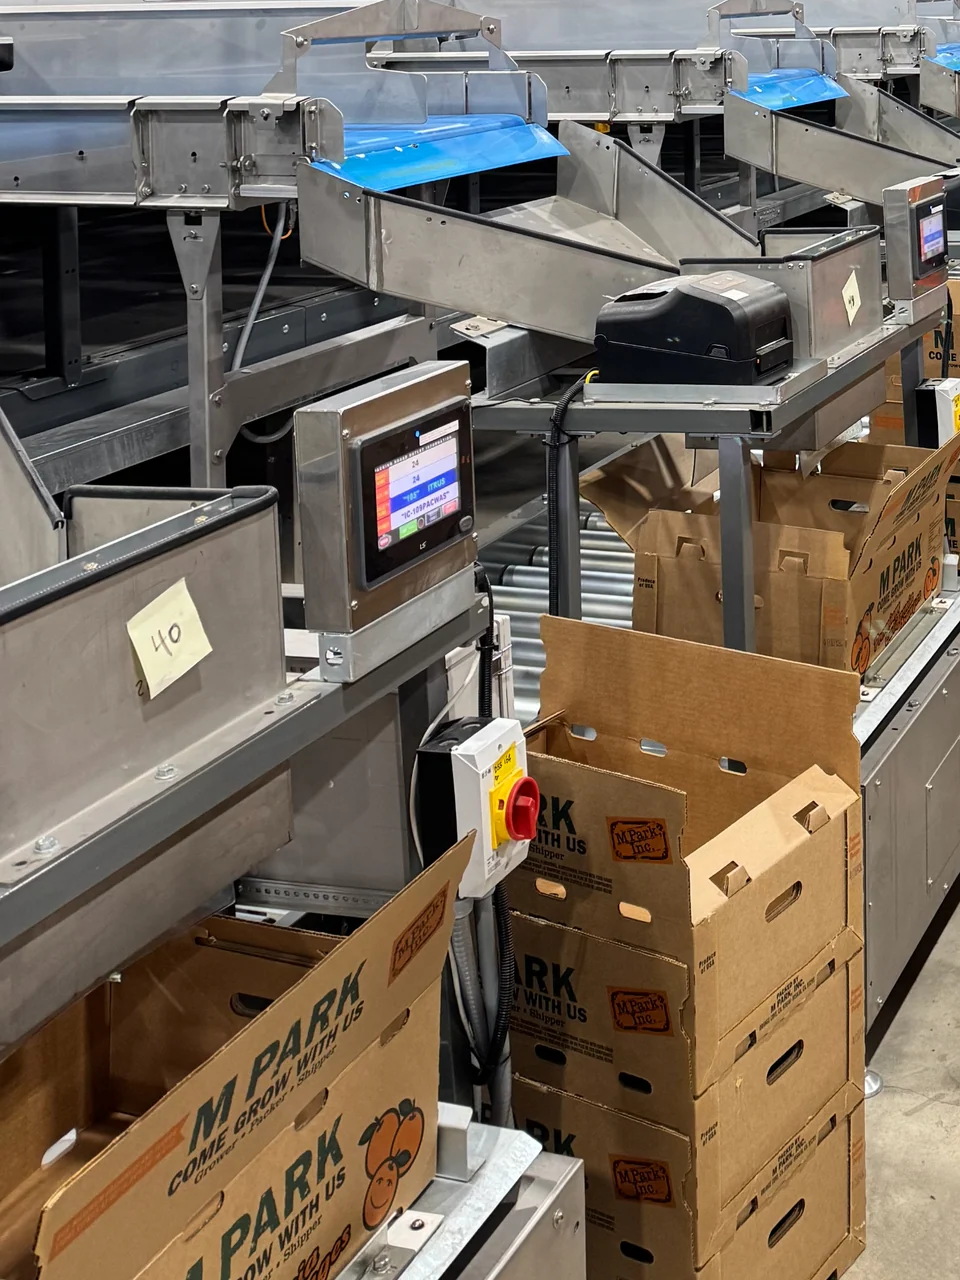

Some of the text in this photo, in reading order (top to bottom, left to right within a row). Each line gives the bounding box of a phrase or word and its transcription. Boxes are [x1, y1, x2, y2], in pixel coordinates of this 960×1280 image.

[928, 350, 957, 362] COE
[411, 458, 420, 469] 24
[412, 473, 421, 484] 24
[427, 476, 446, 492] ITRUS
[419, 541, 427, 550] LS
[879, 531, 922, 599] M PARK
[151, 622, 182, 657] 40
[566, 836, 587, 856] US
[615, 830, 627, 845] M
[631, 841, 656, 856] Inc.
[698, 951, 717, 969] Produce
[706, 959, 716, 970] USA
[770, 978, 805, 1014] M PARK, INC.
[776, 975, 799, 1000] PACKED BY
[524, 988, 588, 1024] WITH US
[616, 1001, 629, 1016] M
[529, 1009, 566, 1029] Shipper
[632, 1013, 657, 1026] Inc.
[187, 958, 368, 1157] M PARK
[166, 1126, 228, 1198] COME
[233, 1066, 293, 1132] GROW
[296, 1022, 338, 1077] WITH
[342, 999, 365, 1033] US
[193, 1043, 338, 1186] Grower Packer Shipper
[700, 1121, 718, 1140] Produce
[708, 1130, 717, 1142] USA
[771, 1137, 807, 1177] M PARK, INC.
[777, 1136, 801, 1163] PACKED BY
[618, 1169, 631, 1185] M
[220, 1112, 345, 1280] PARK
[635, 1181, 658, 1197] Inc.
[278, 1166, 346, 1251] WITH US
[283, 1214, 323, 1264] Shipper
